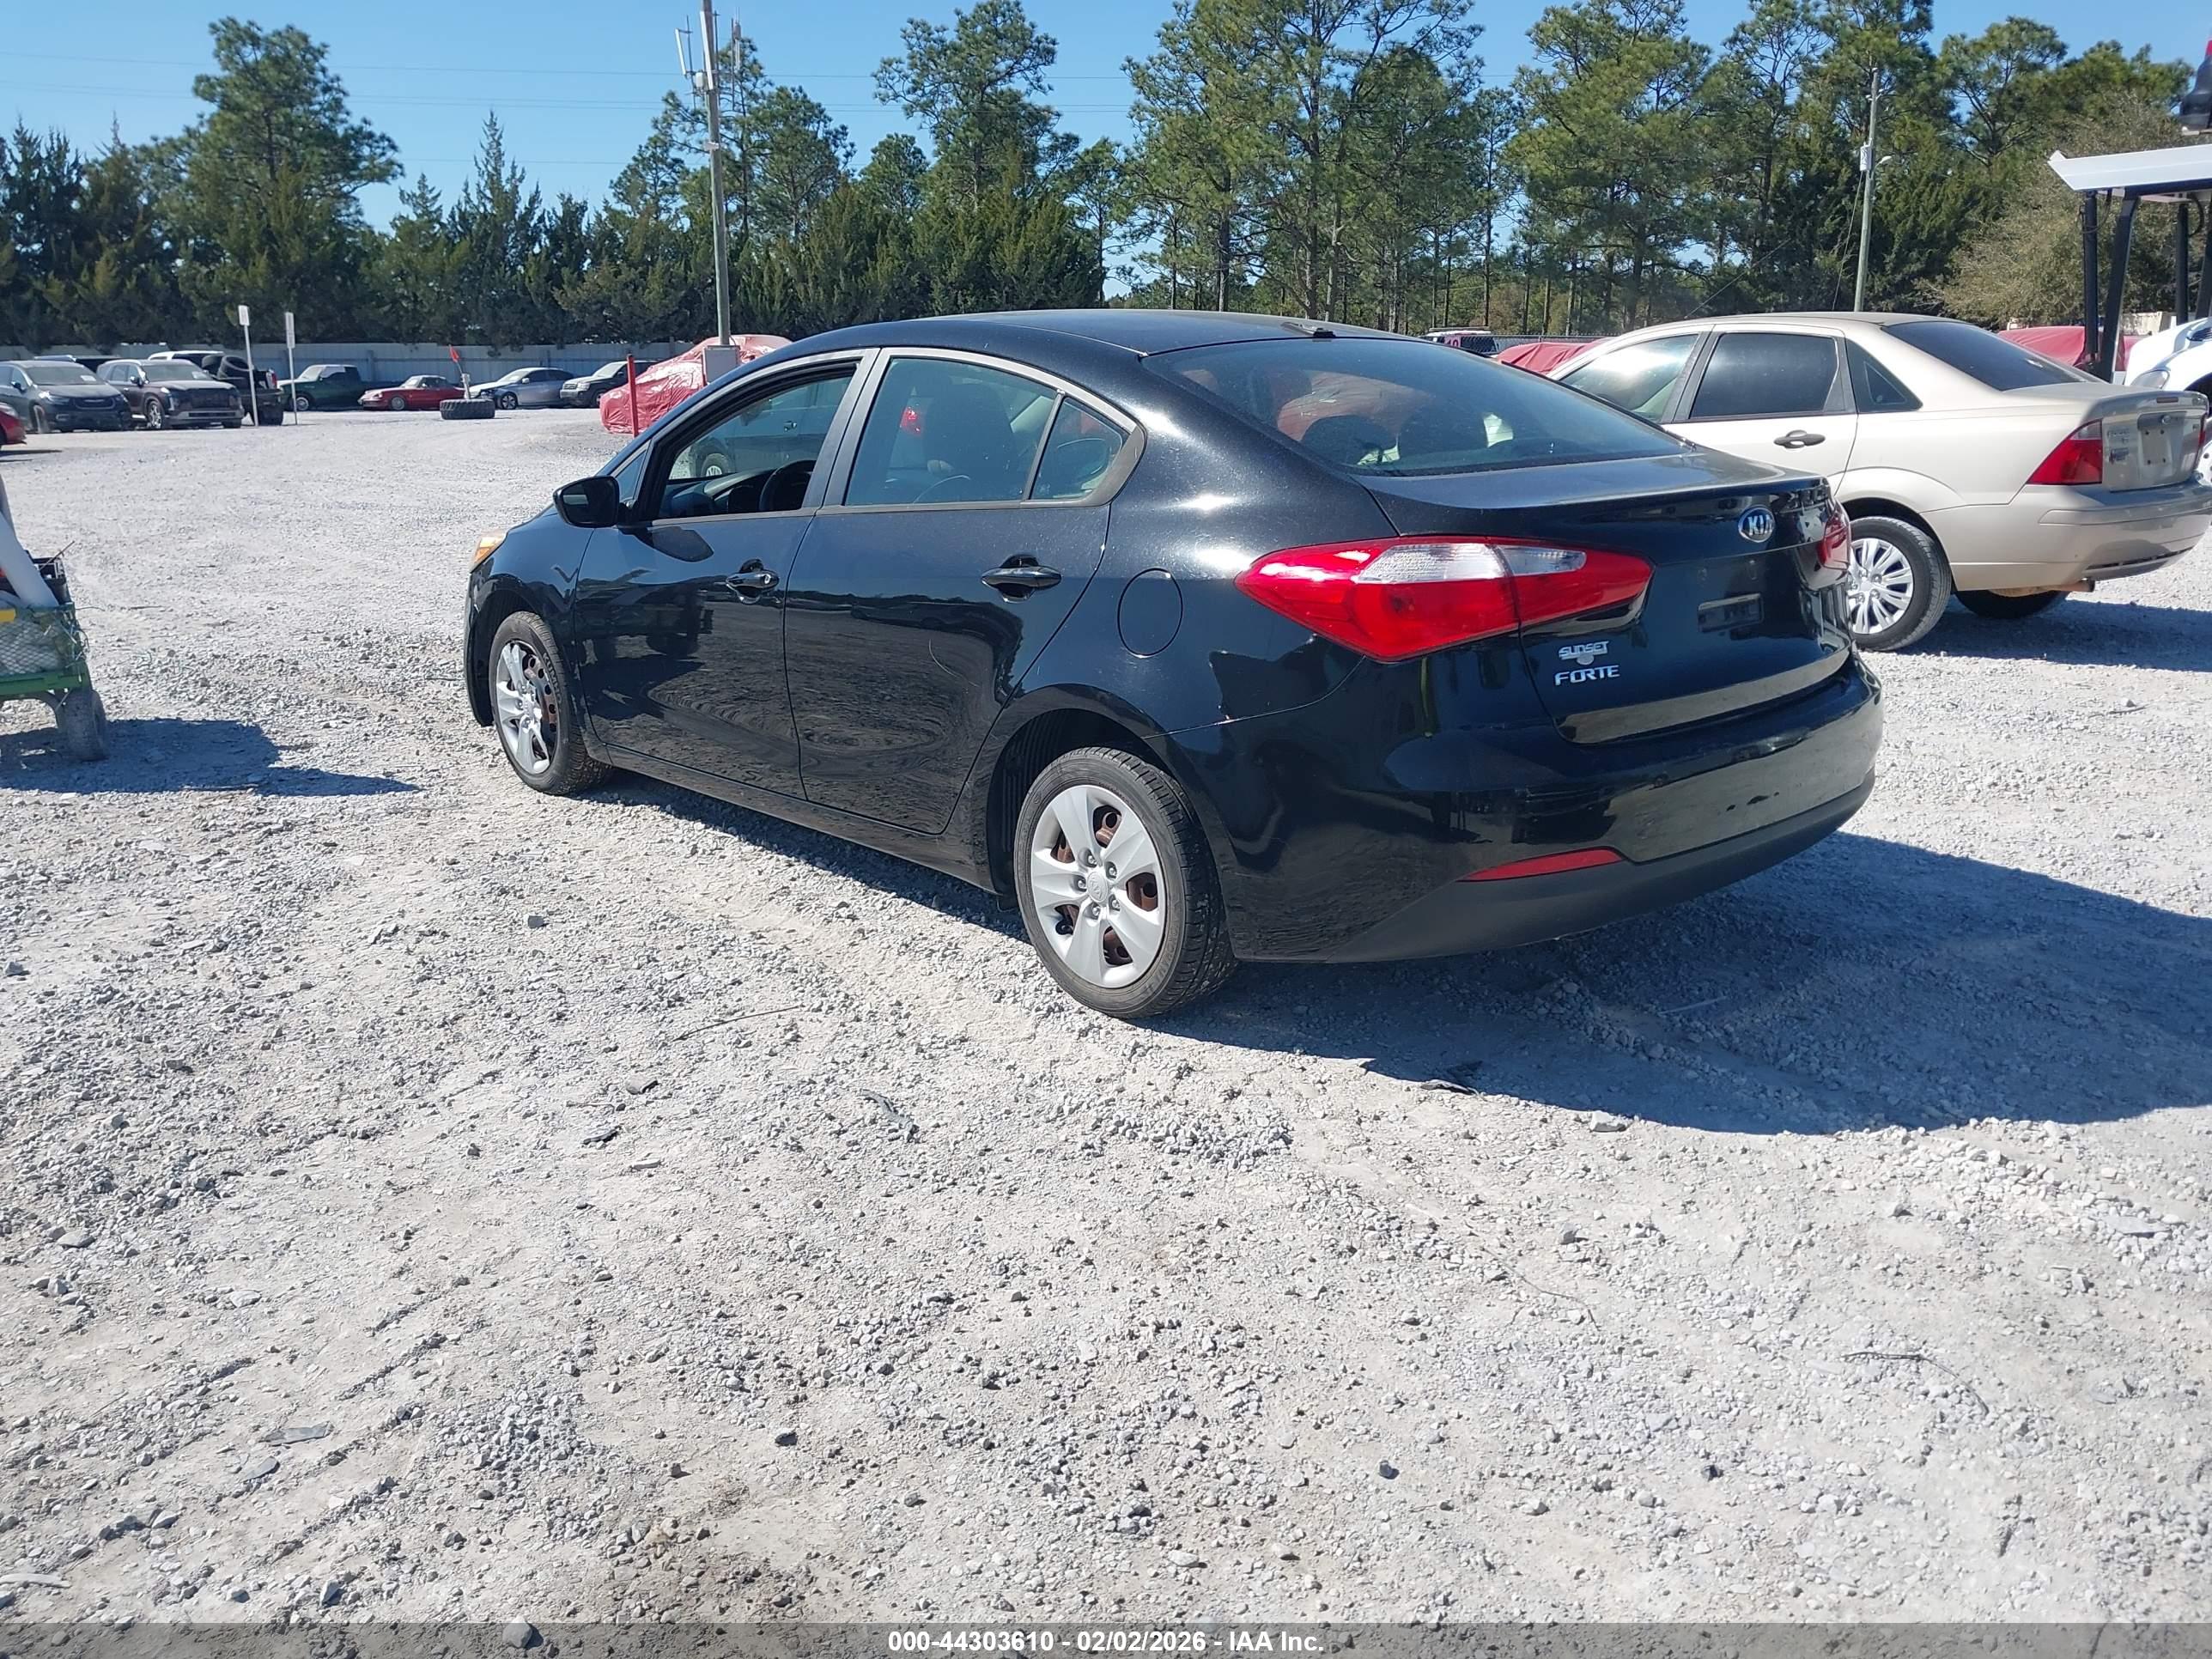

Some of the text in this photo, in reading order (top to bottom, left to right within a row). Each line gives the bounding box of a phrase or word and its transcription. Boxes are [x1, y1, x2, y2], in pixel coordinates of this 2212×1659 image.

[1747, 514, 1773, 536] KIA
[1558, 641, 1609, 659] SUNSET
[1554, 665, 1620, 686] FORTE
